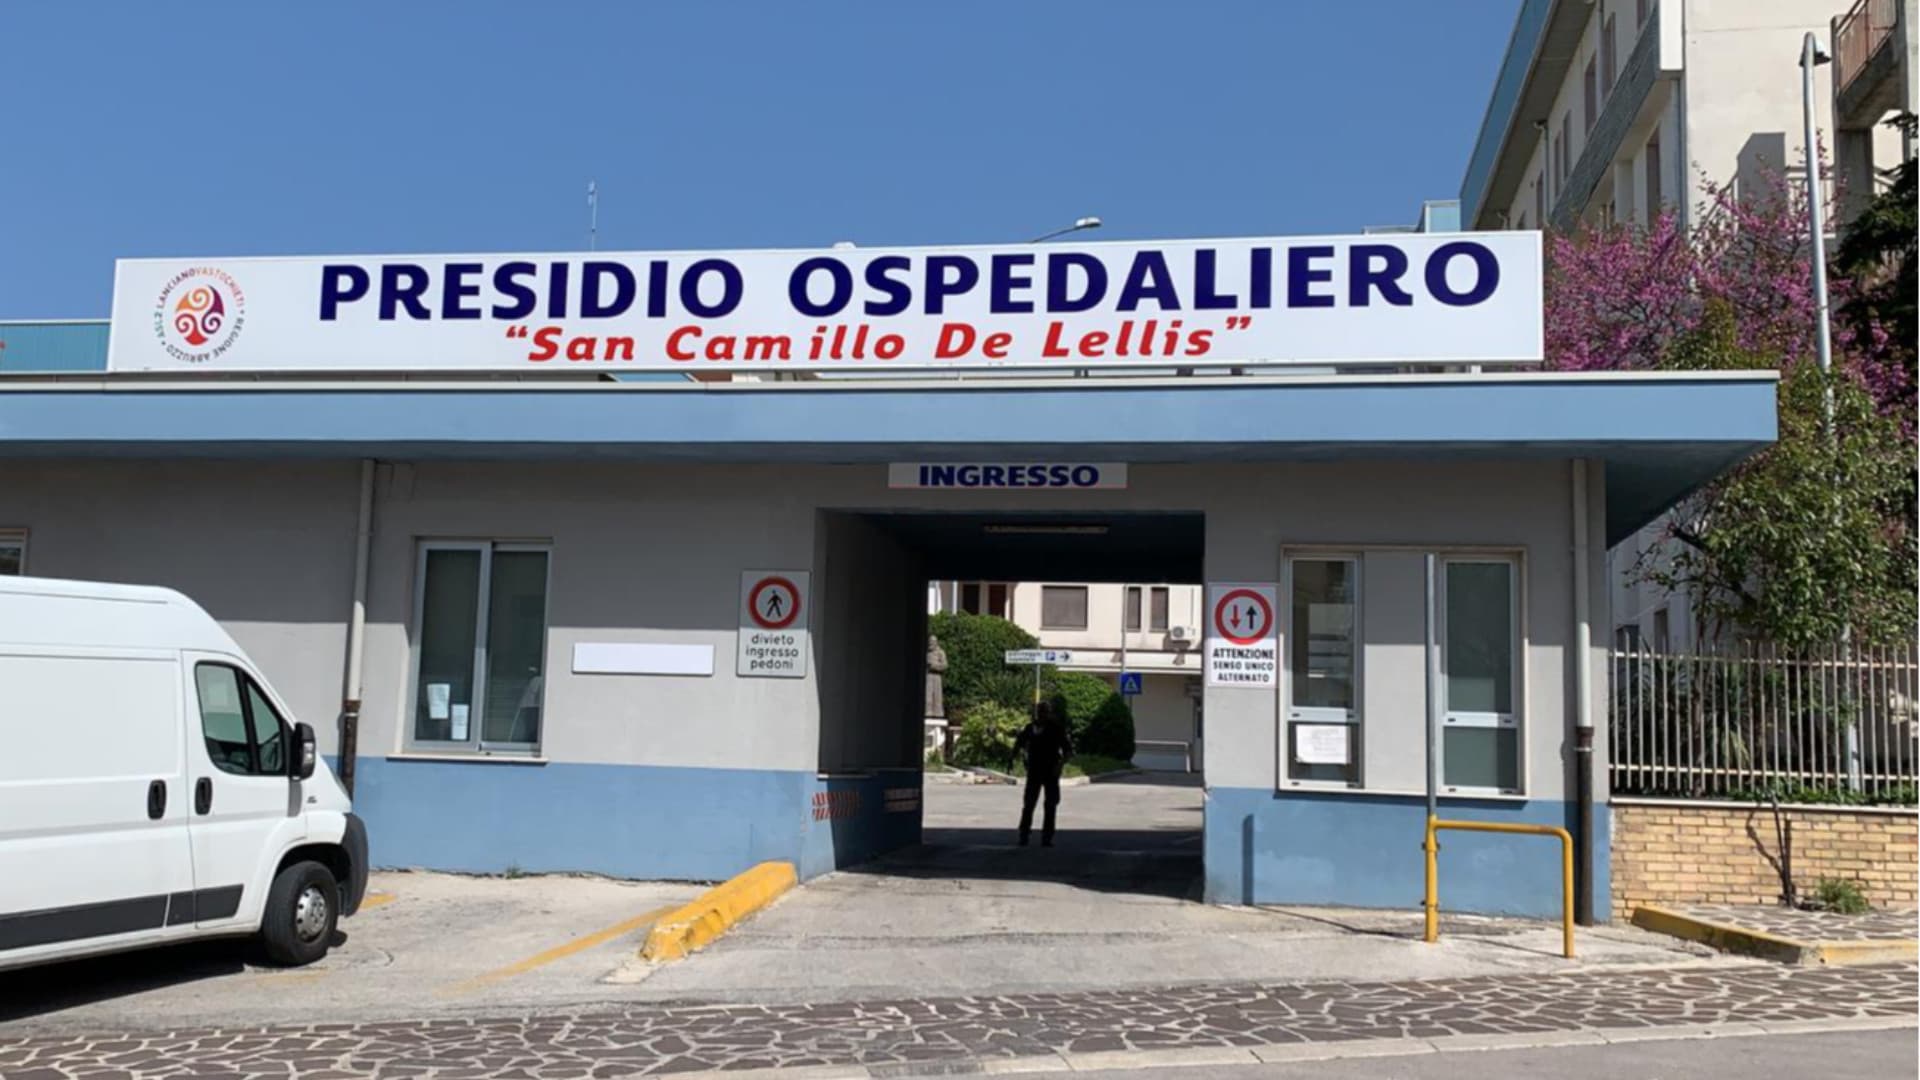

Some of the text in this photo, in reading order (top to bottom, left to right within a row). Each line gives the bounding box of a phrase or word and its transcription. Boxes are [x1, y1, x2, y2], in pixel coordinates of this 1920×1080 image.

[318, 240, 1500, 321] PRESIDIO OSPEDALIERO
[665, 325, 905, 361] Camillo
[935, 322, 1013, 359] De
[918, 465, 1100, 486] INGRESSO
[751, 634, 795, 645] divieto
[745, 645, 799, 658] ingresso
[1212, 647, 1274, 660] ATTENZIONE
[750, 658, 794, 671] pedoni
[1213, 661, 1274, 671] SENSO UNICO
[1217, 672, 1270, 683] ALTERNATO
